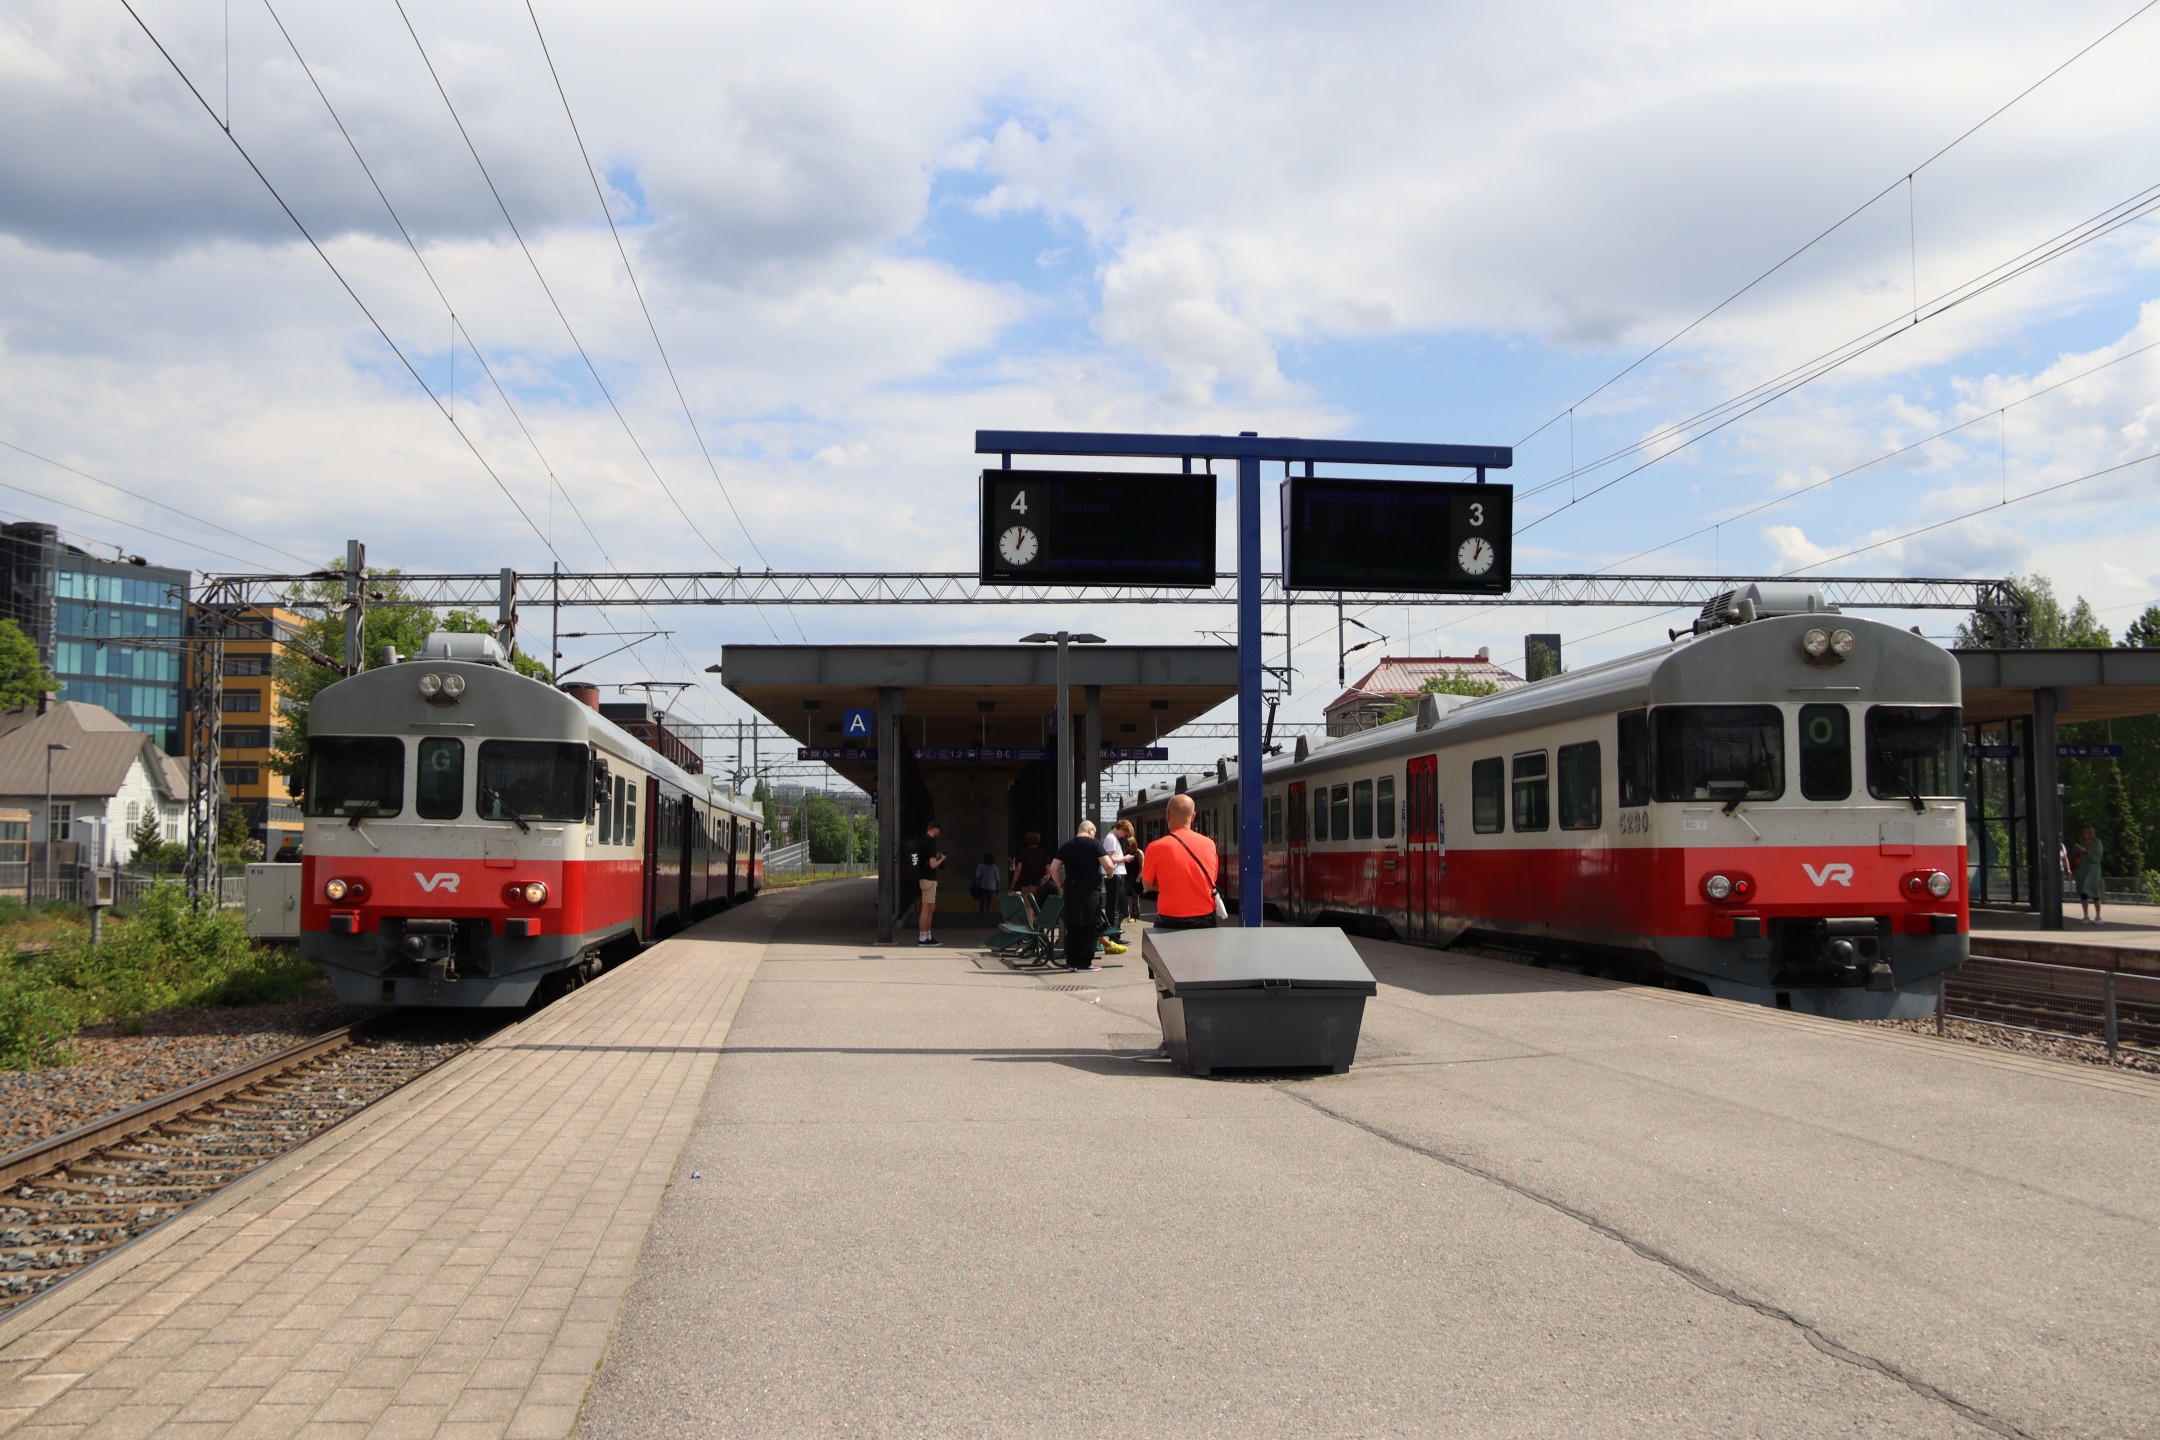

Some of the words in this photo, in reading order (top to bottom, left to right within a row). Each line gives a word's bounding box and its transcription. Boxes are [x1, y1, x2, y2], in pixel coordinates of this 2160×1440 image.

[1010, 490, 1028, 515] 4
[1469, 502, 1484, 526] 3
[850, 714, 866, 731] A
[431, 749, 451, 772] G
[859, 750, 867, 758] A
[996, 750, 1011, 758] B-E
[1146, 750, 1153, 758] A
[2103, 747, 2110, 755] A
[1619, 811, 1649, 834] 6290
[414, 872, 460, 893] VR
[1801, 863, 1854, 887] VR
